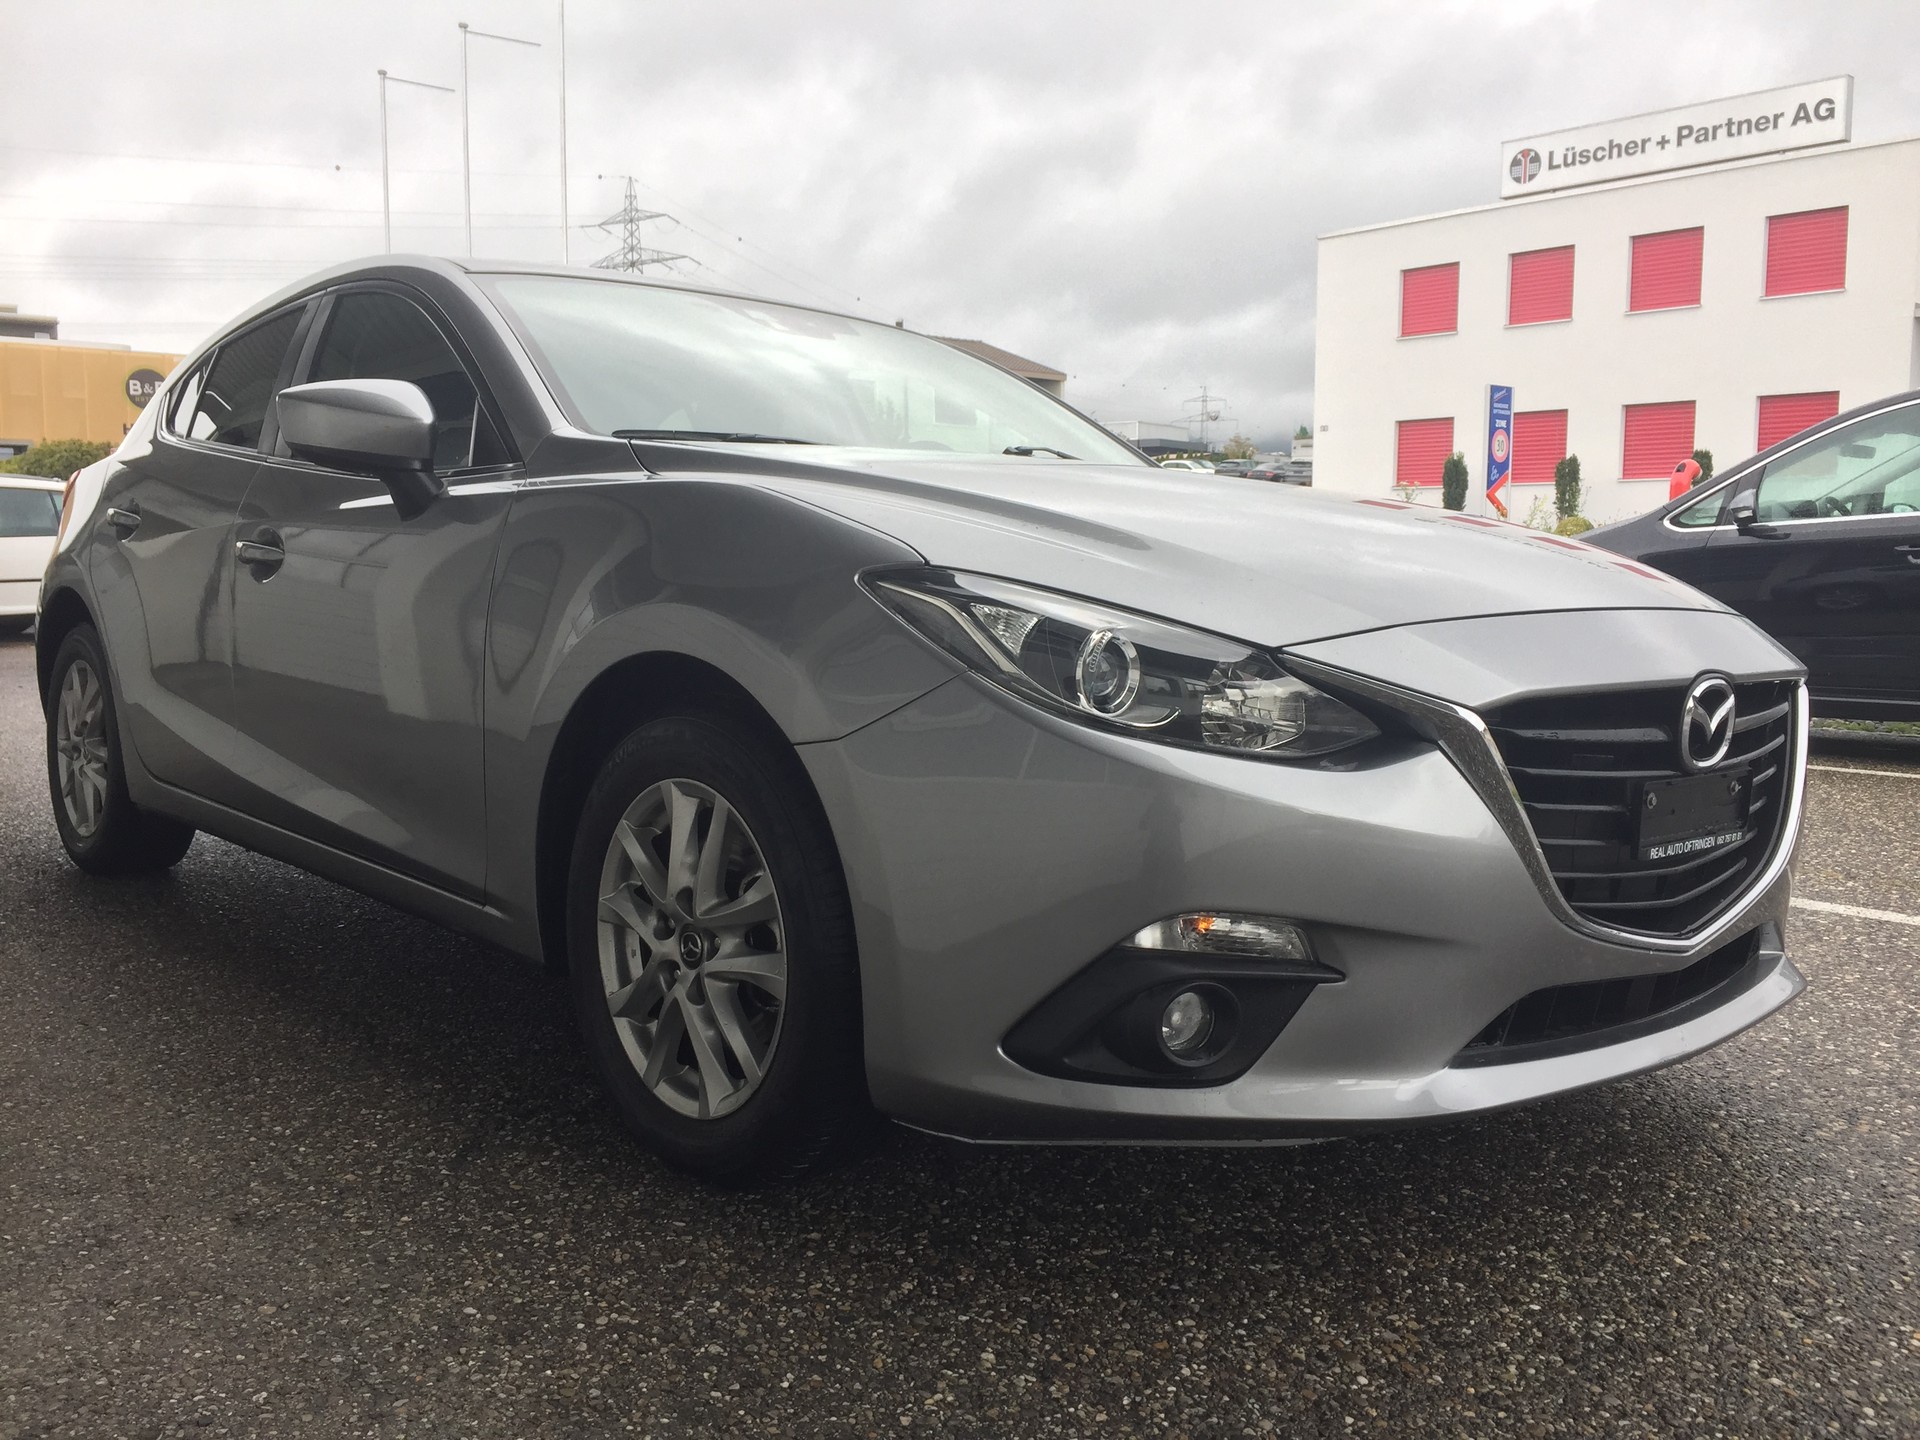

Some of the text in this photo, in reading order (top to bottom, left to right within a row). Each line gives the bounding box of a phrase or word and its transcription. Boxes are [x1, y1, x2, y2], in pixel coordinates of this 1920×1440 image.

[1548, 97, 1836, 171] Lüscher + Partner AG
[1495, 419, 1507, 428] ZONE
[1496, 439, 1504, 452] 30
[1650, 846, 1666, 859] REAL
[1666, 842, 1683, 856] AUTO
[1684, 836, 1716, 852] OFTRINGEN
